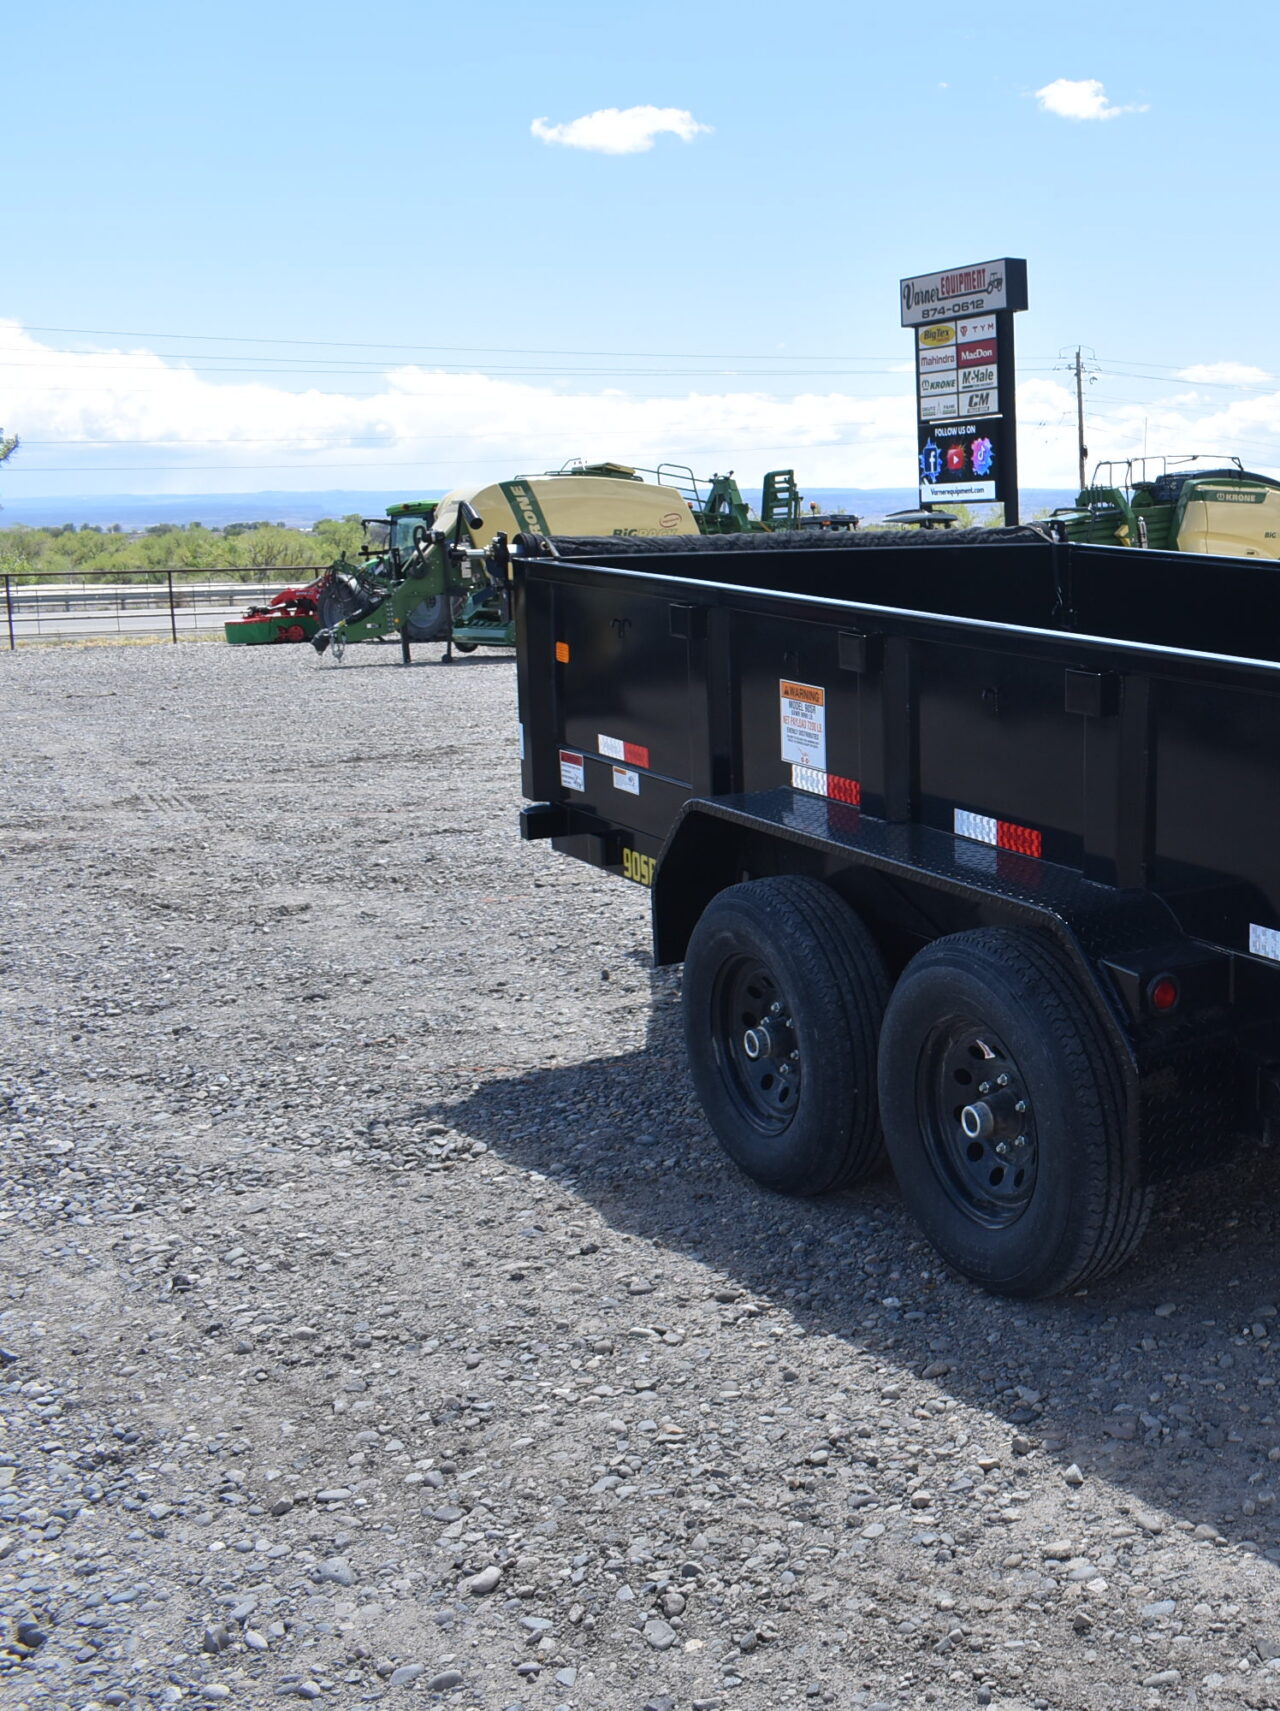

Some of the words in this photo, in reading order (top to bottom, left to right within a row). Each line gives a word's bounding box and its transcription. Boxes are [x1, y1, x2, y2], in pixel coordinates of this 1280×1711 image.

[903, 281, 939, 310] Varner
[940, 268, 986, 296] EQUIPMENT
[921, 299, 984, 319] 874-0612
[920, 354, 955, 367] Mahindra
[961, 349, 993, 361] MacDon
[930, 379, 956, 390] KRONE
[968, 392, 990, 408] CM
[934, 427, 957, 437] FOLLOW
[957, 426, 966, 435] US
[966, 425, 976, 434] ON
[1225, 493, 1257, 502] KRONE
[510, 485, 543, 535] RONE
[789, 686, 820, 703] WARNING
